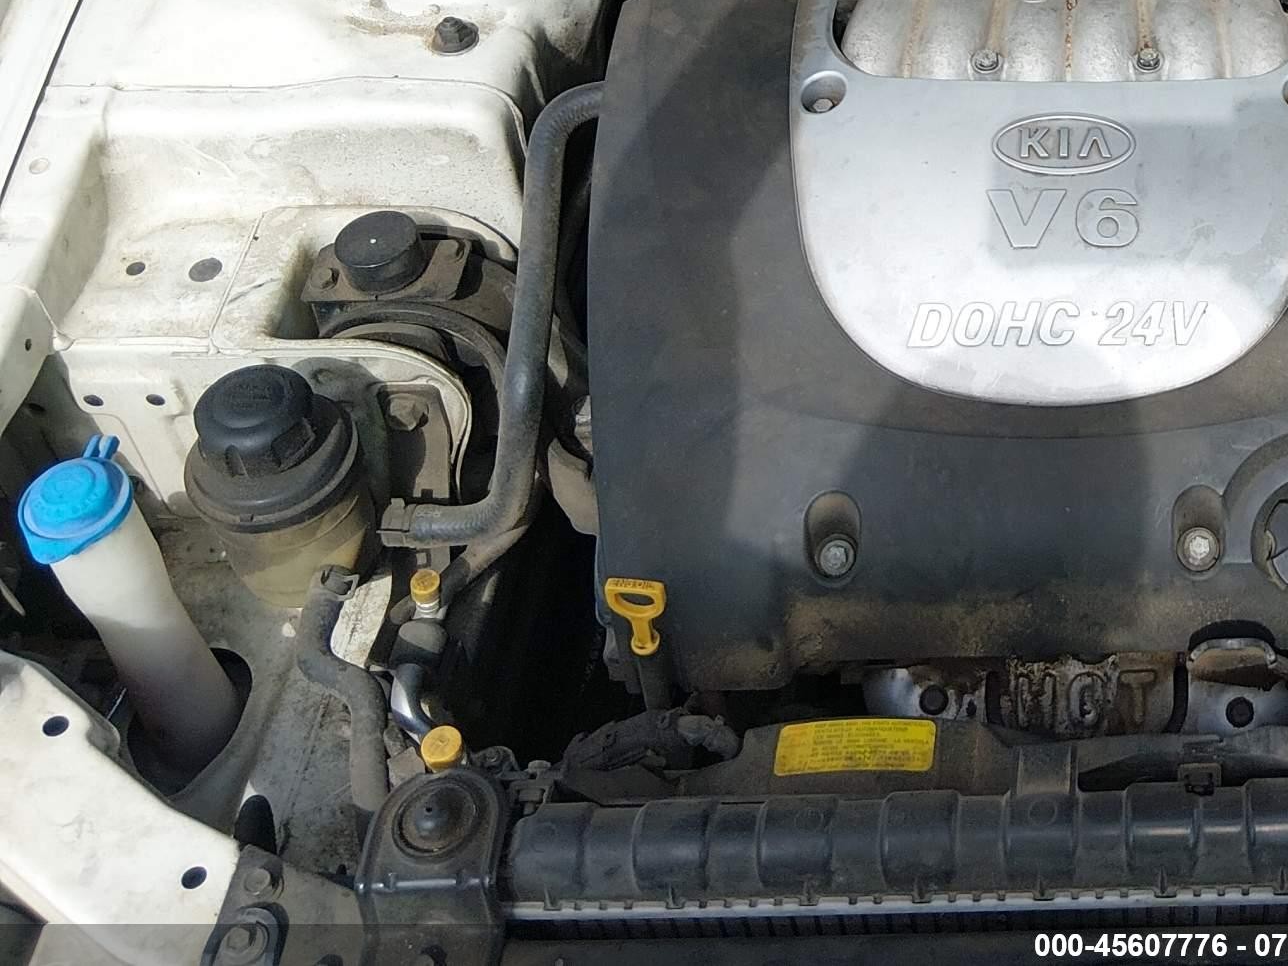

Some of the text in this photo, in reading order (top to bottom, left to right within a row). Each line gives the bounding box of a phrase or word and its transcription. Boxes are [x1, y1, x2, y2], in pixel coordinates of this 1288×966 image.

[1017, 127, 1113, 158] KIA
[987, 188, 1140, 249] V6
[908, 301, 1209, 347] DOHC 24V
